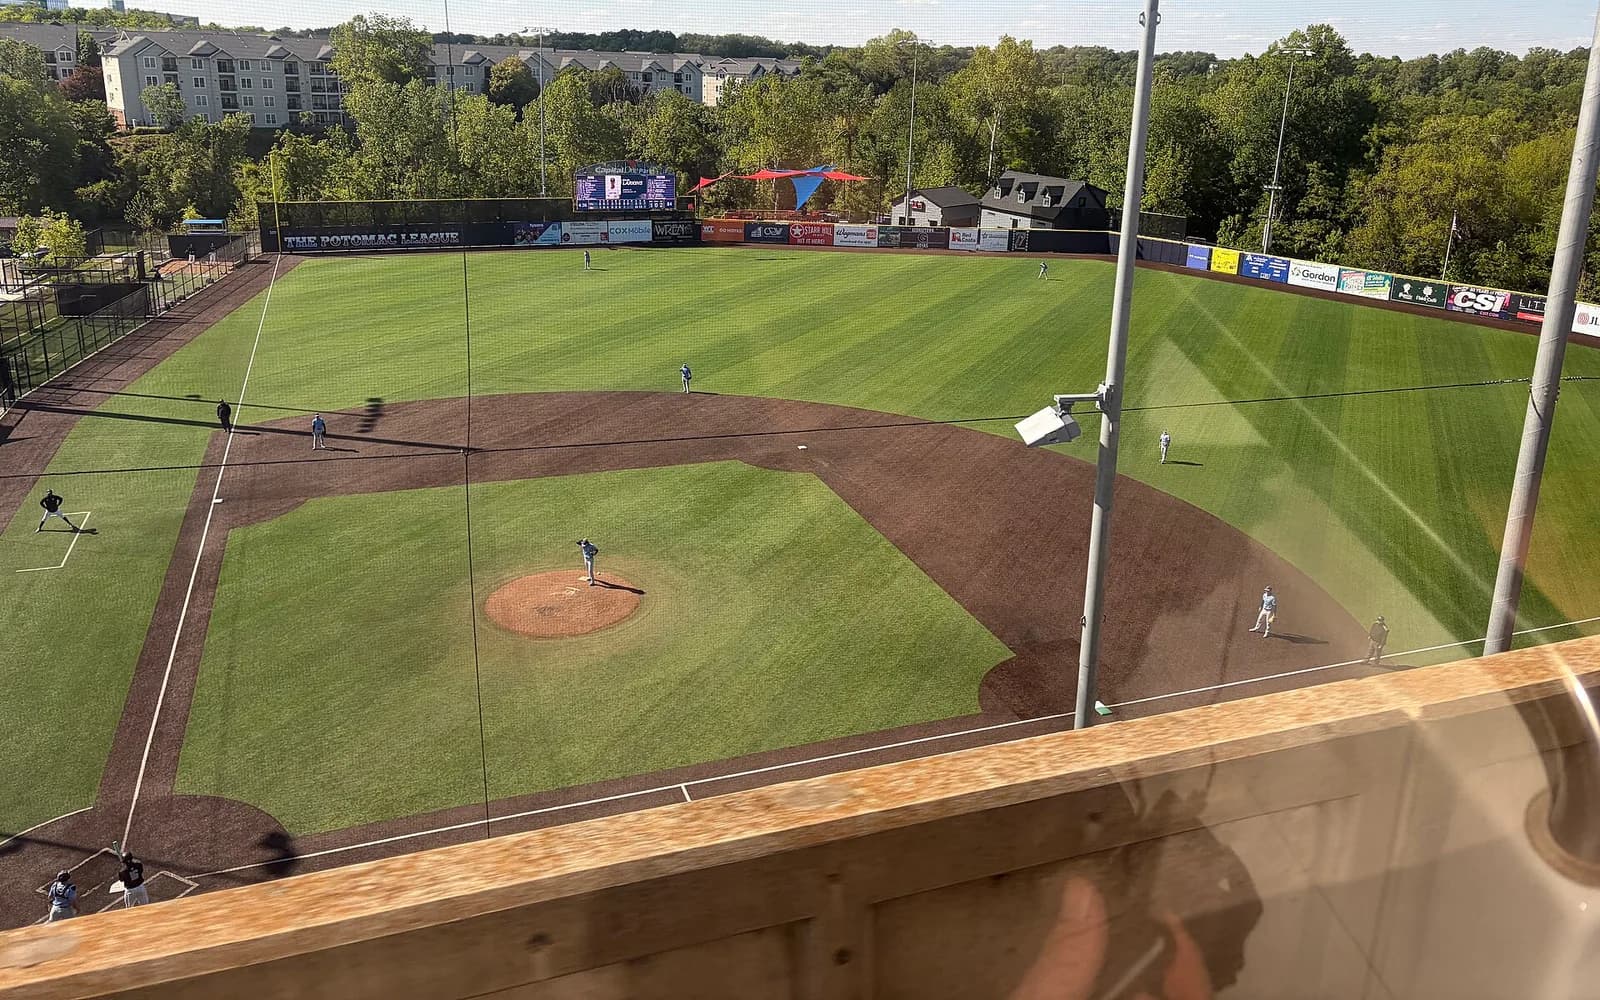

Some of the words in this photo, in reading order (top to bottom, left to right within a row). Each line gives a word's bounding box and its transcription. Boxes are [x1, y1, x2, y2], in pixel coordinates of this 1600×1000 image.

[609, 227, 628, 235] COX
[284, 236, 318, 249] THE
[320, 233, 397, 247] POTOMAC
[400, 232, 460, 245] LEAGUE
[1301, 269, 1336, 283] Gordon
[1453, 291, 1506, 313] CSI
